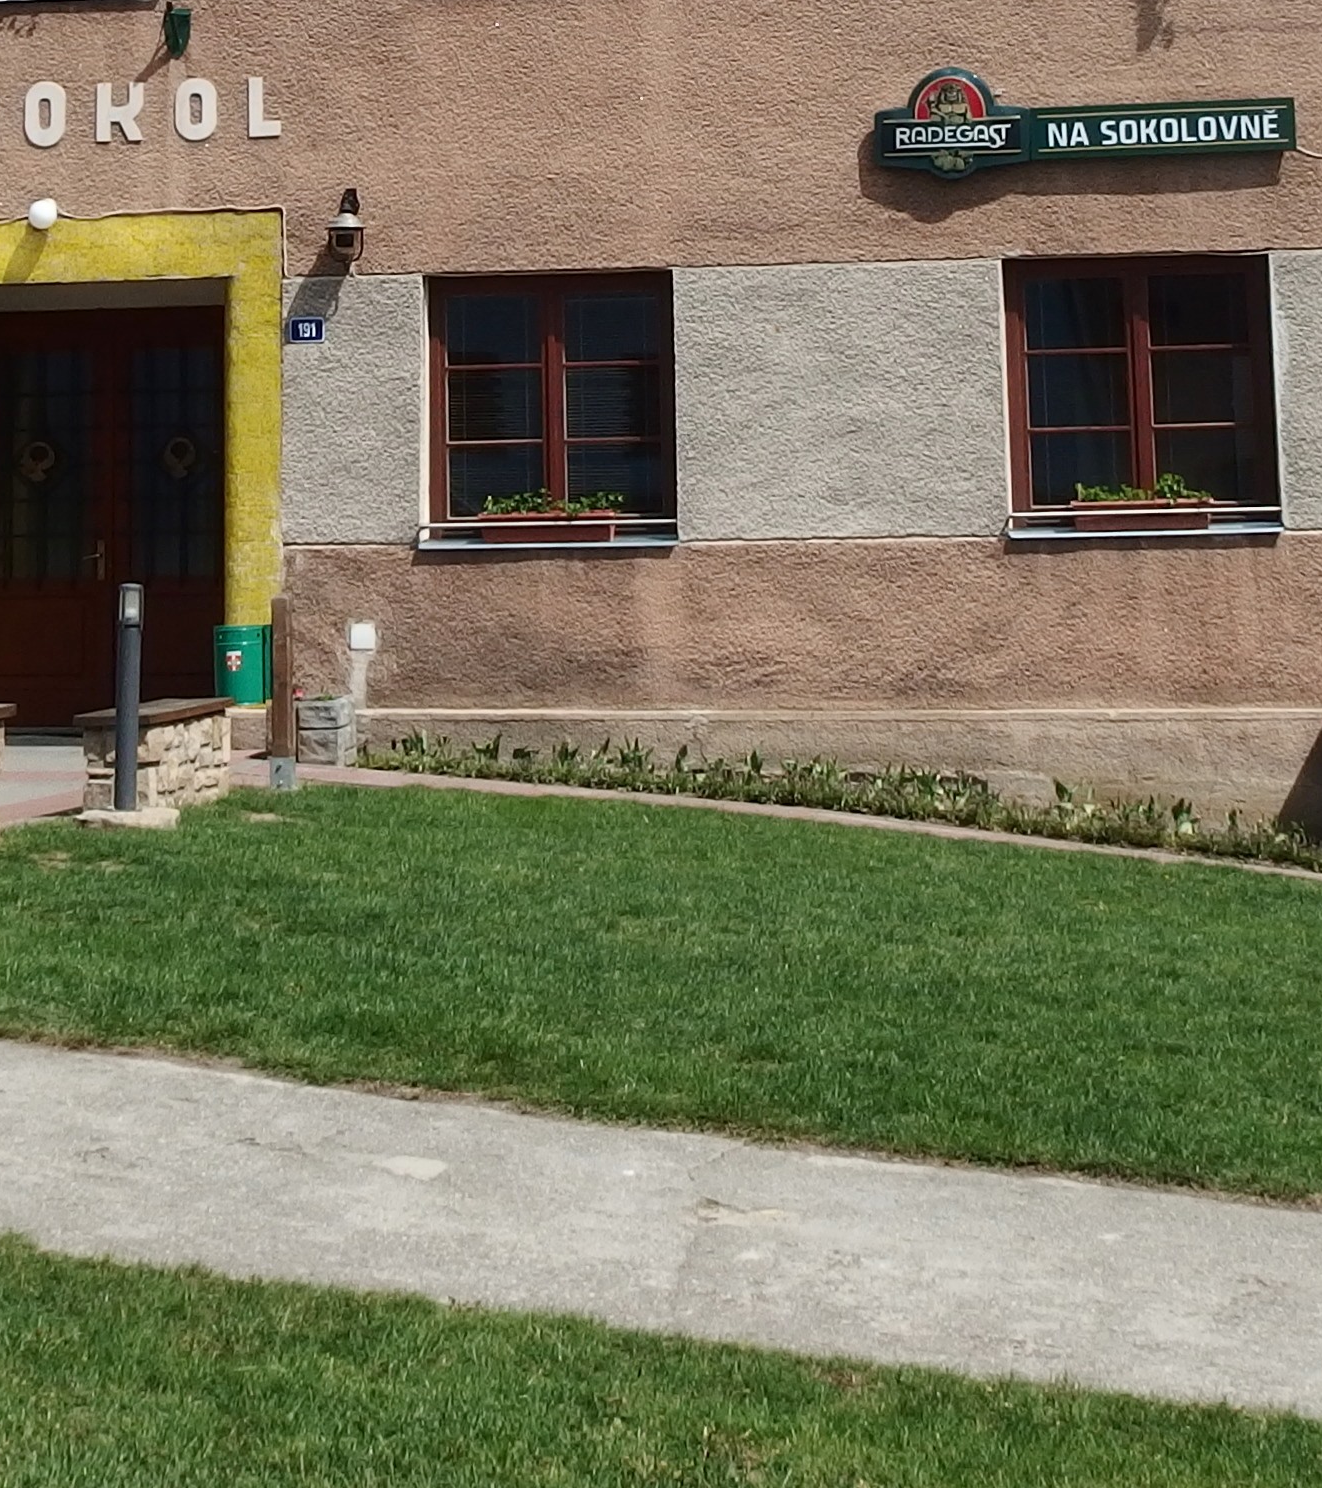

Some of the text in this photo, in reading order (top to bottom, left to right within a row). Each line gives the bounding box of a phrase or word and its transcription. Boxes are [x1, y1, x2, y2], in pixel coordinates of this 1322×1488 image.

[895, 123, 1011, 149] RADEGAST
[1047, 109, 1280, 148] NA SOKOLOVNĚ
[298, 322, 316, 338] 191
